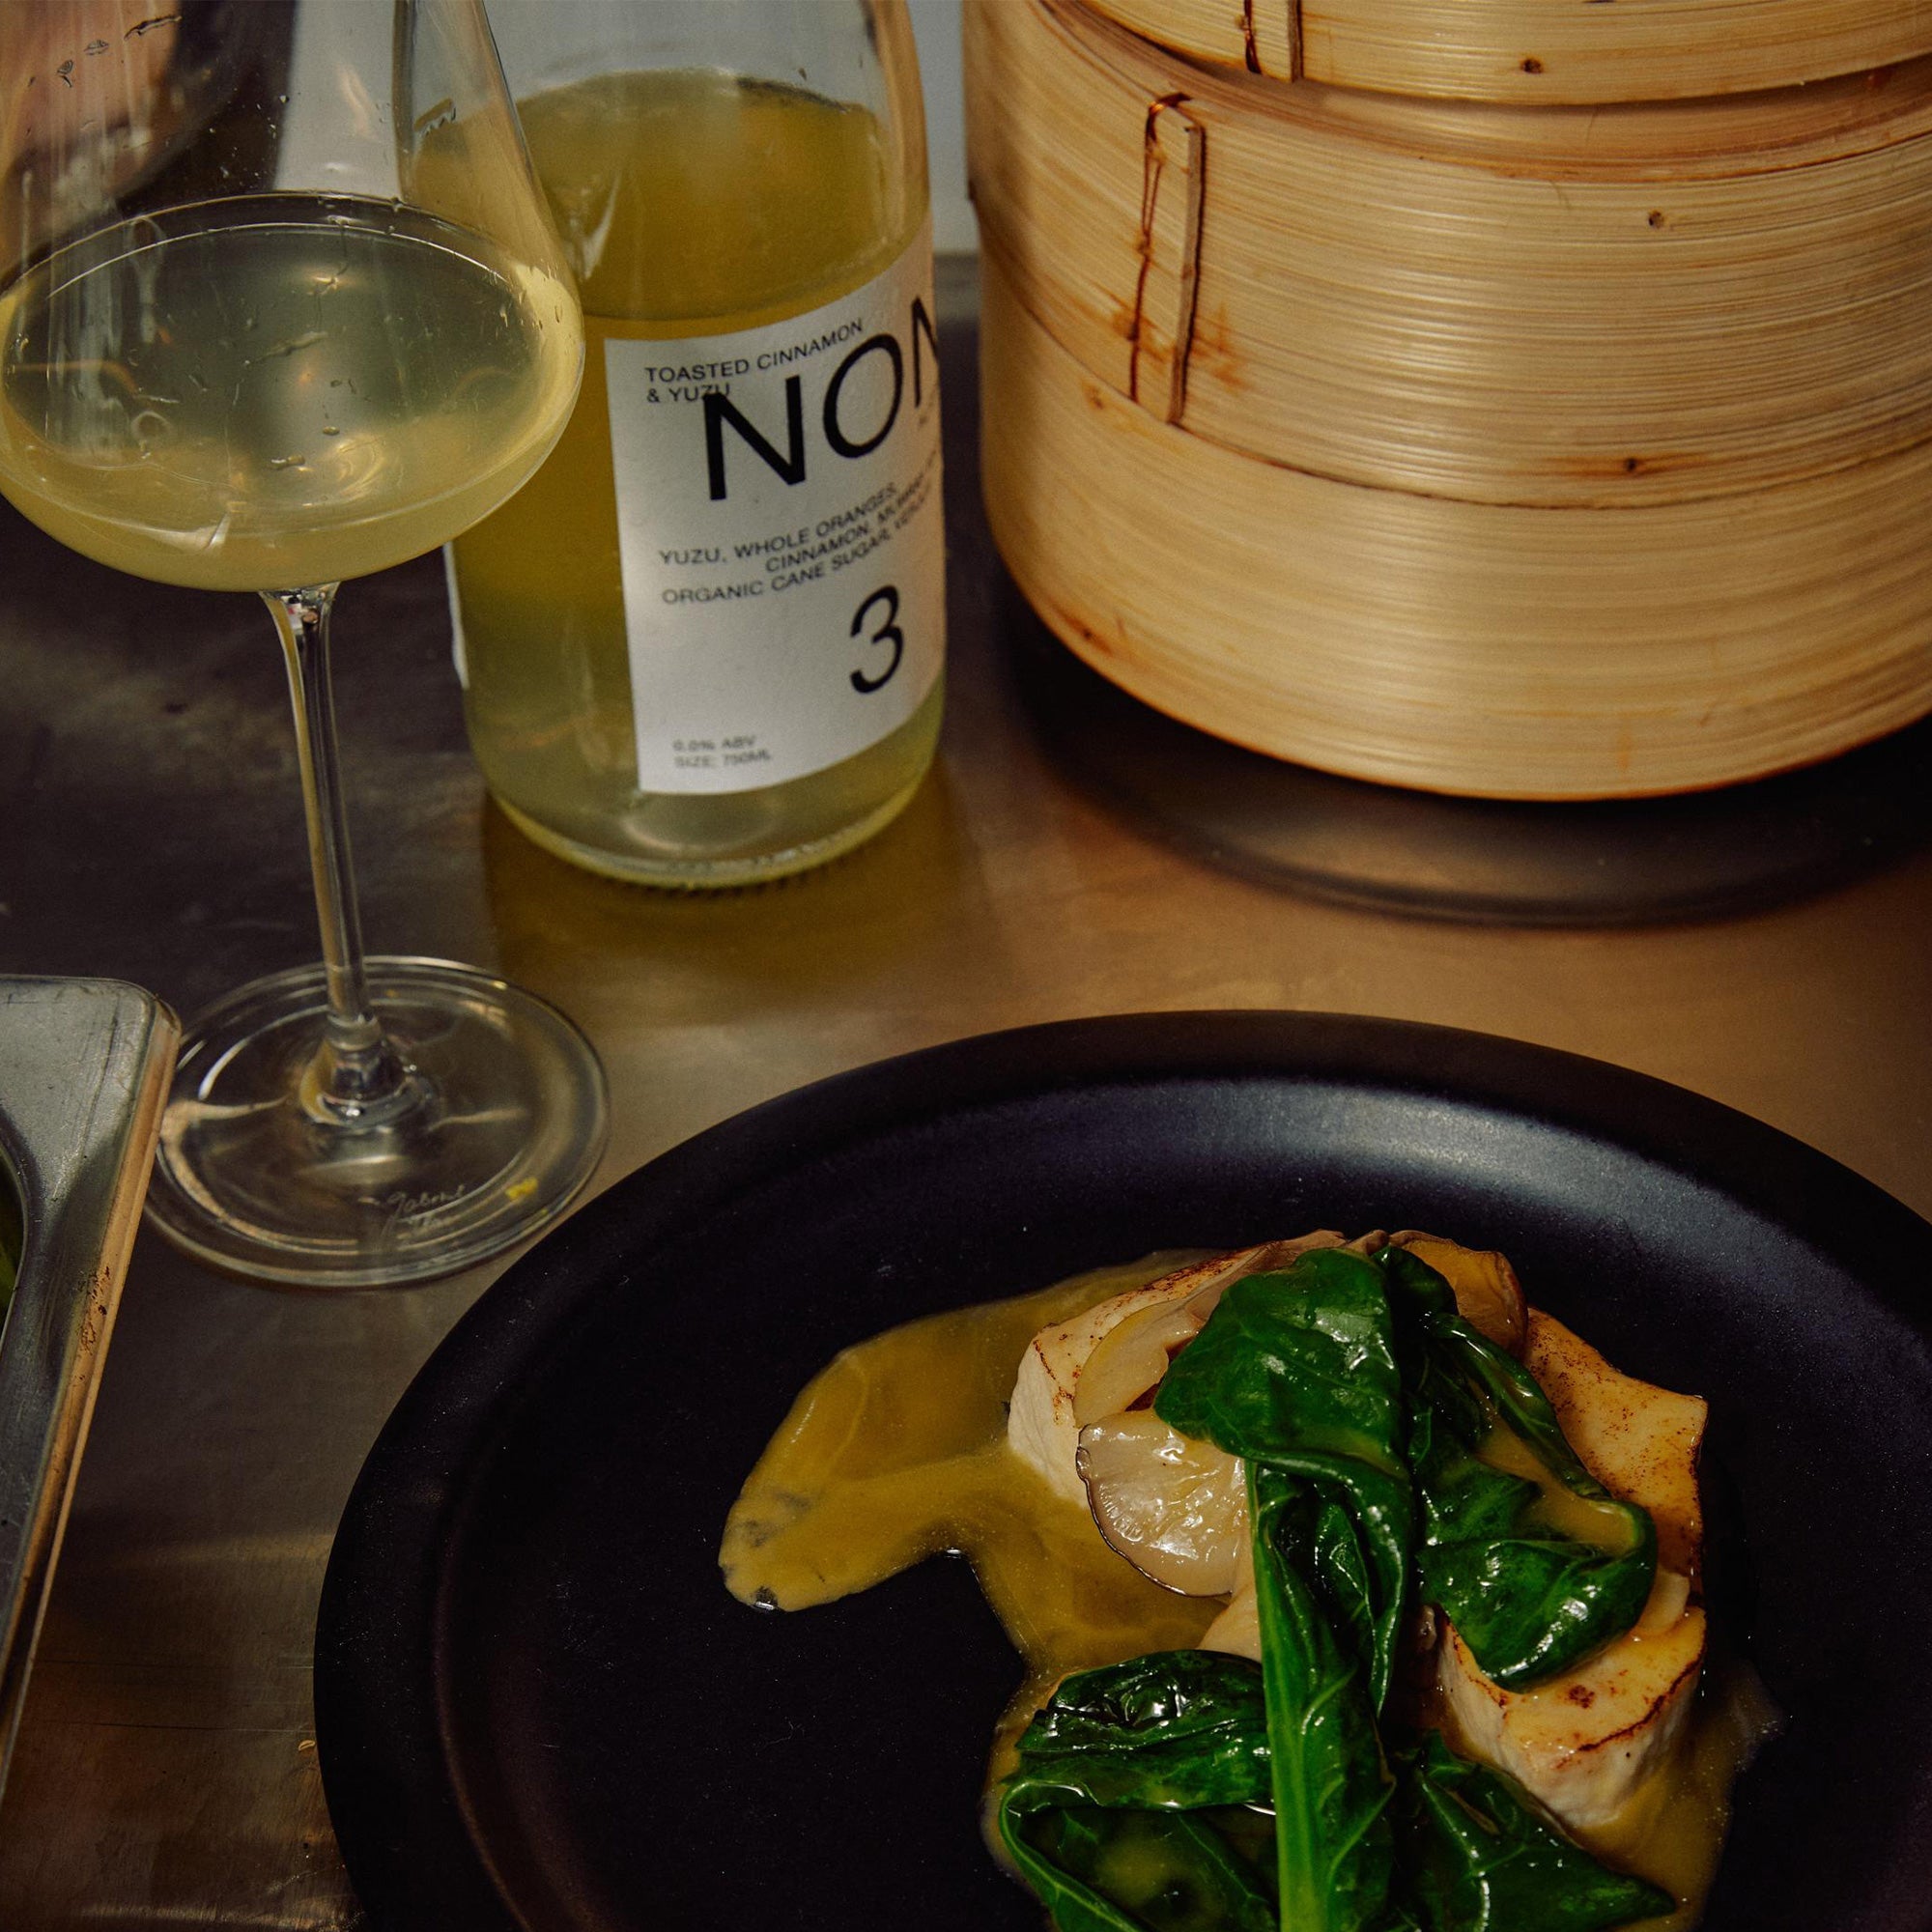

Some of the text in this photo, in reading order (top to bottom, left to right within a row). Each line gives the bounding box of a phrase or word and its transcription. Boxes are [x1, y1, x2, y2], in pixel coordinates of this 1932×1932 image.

[644, 318, 863, 384] TOASTED CINNAMON
[646, 383, 730, 403] & YUZU
[734, 527, 810, 558] WHOLE
[765, 521, 869, 573] CINNAMON
[661, 581, 764, 605] ORGANIC
[771, 562, 825, 591] CANE
[850, 584, 903, 694] 3
